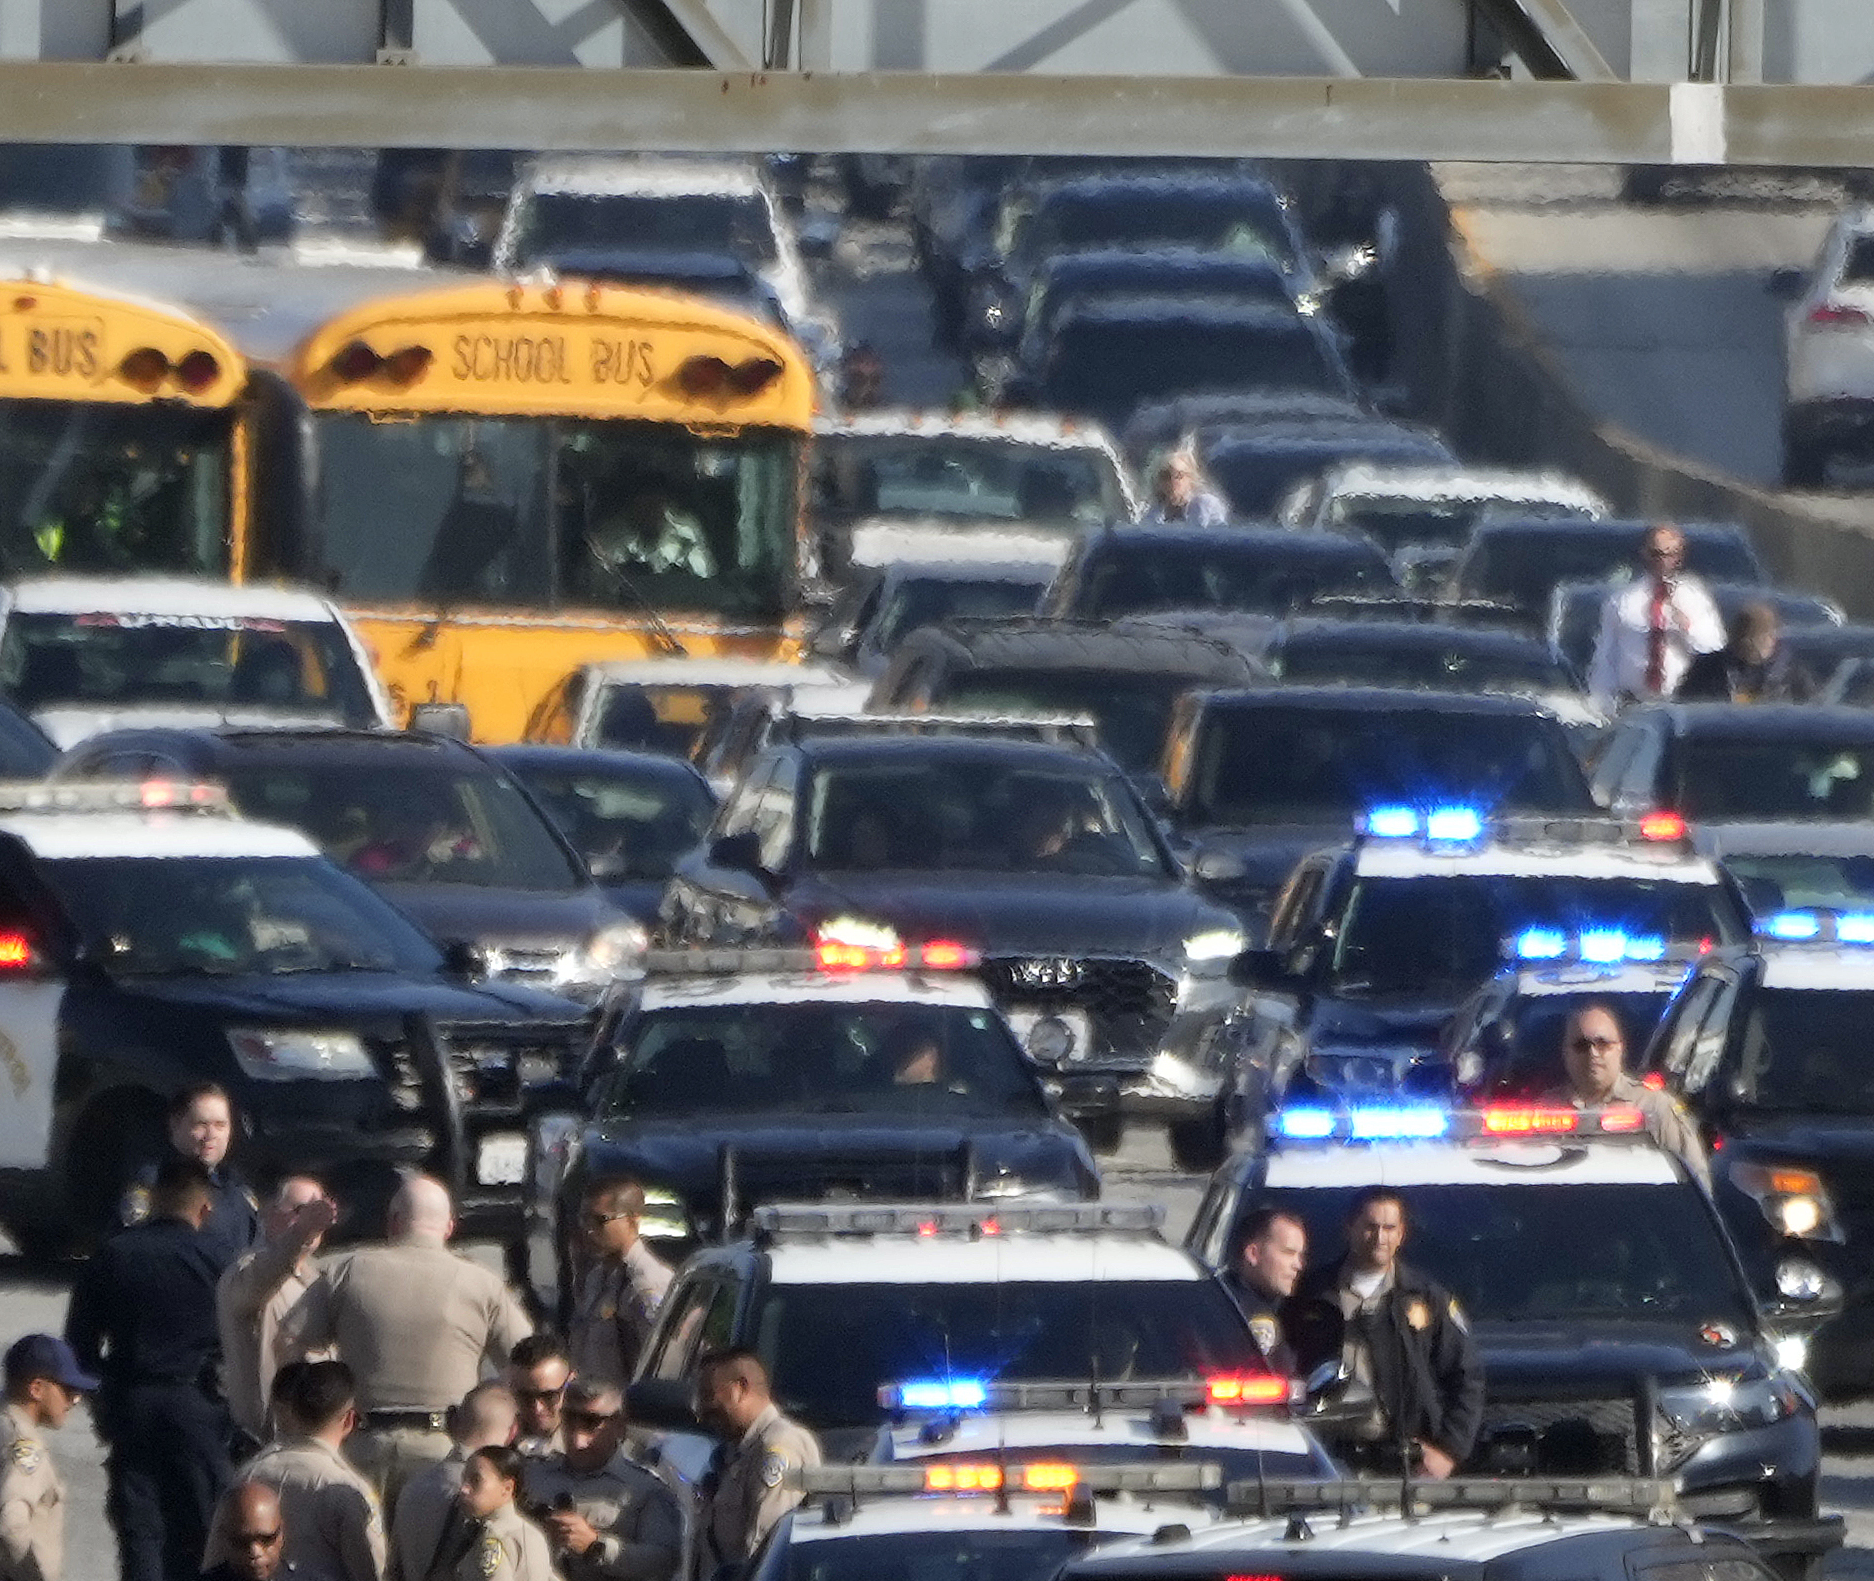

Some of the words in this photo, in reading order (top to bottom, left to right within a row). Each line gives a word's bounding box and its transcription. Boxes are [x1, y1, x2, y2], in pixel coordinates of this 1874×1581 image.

[28, 328, 99, 378] BUS
[452, 334, 571, 384] SCHOOL
[590, 338, 653, 387] BUS
